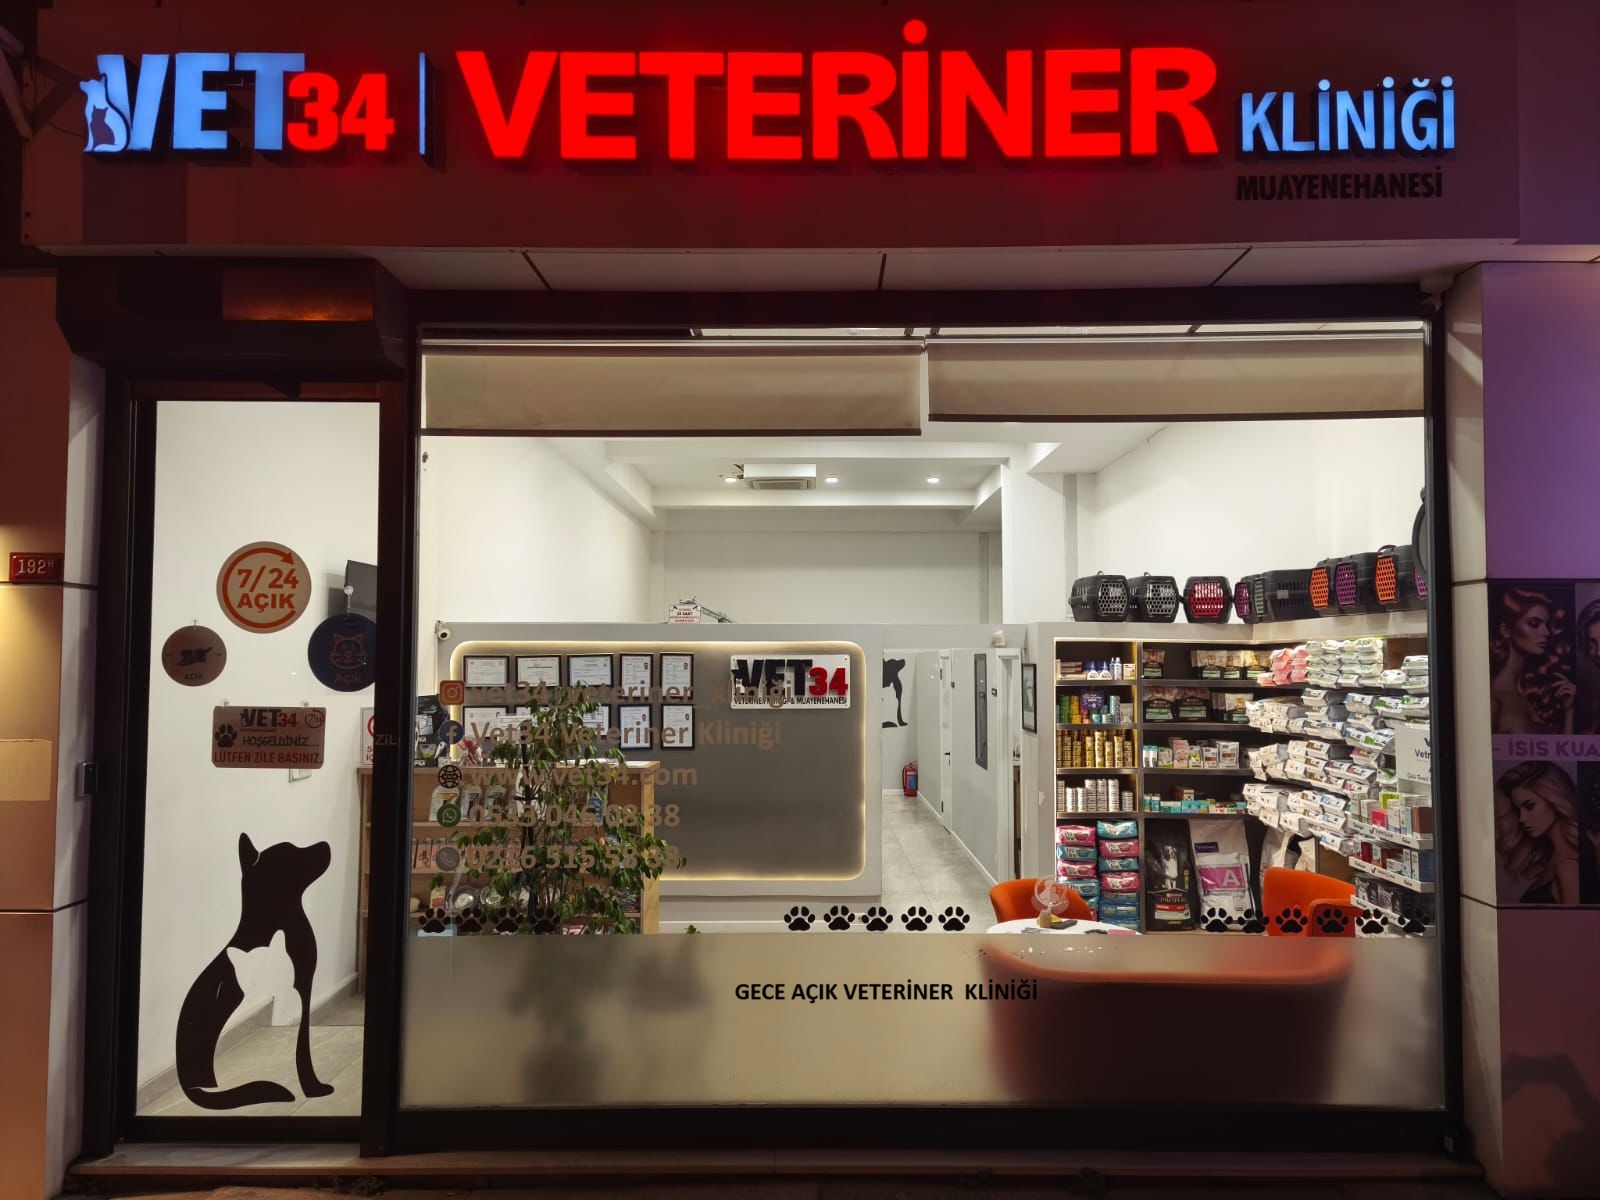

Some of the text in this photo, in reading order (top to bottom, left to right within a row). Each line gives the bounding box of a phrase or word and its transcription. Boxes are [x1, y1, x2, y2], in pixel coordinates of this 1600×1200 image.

[97, 20, 1455, 159] VET34 VETERİNER KLİNİĞİ
[1236, 166, 1443, 201] MUAYENEHANESİ
[237, 565, 299, 594] 7/24
[236, 593, 296, 614] AÇIK
[243, 708, 298, 728] VET34
[471, 719, 549, 744] Vet34
[559, 720, 688, 744] Veteriner
[700, 719, 782, 749] Kliniği
[214, 750, 251, 763] LÜTFEN
[254, 750, 275, 763] ZİLE
[1508, 738, 1549, 757] İSİS
